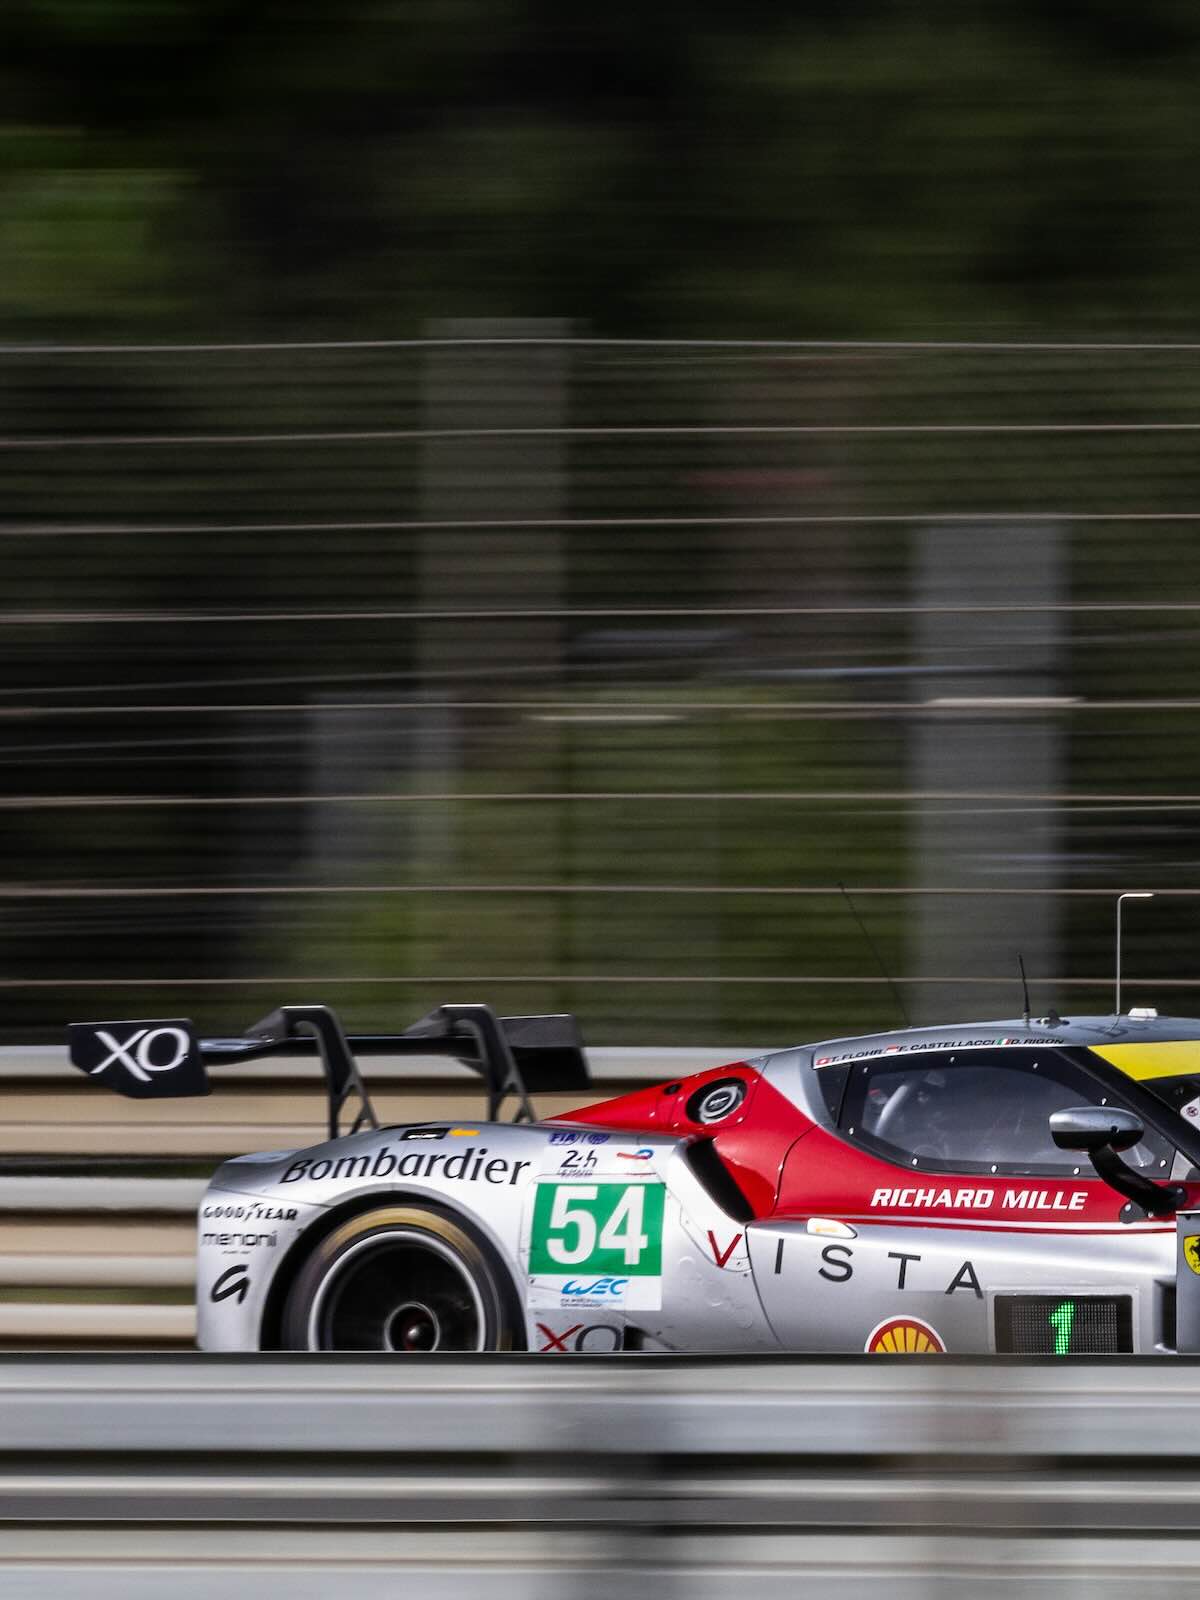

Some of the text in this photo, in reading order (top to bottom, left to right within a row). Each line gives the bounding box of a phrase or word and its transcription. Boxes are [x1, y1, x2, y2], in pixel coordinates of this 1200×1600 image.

[90, 1027, 190, 1082] XO
[841, 1048, 884, 1060] FLOHR
[910, 1039, 996, 1051] CASTELLACCI
[279, 1147, 531, 1185] Bombardier
[560, 1149, 598, 1168] 2h
[870, 1188, 1089, 1211] RICHARD MILLE
[546, 1184, 649, 1266] 54
[707, 1230, 984, 1300] VISTA
[561, 1278, 630, 1296] WEC
[536, 1323, 623, 1352] XO
[1049, 1301, 1075, 1353] 1
